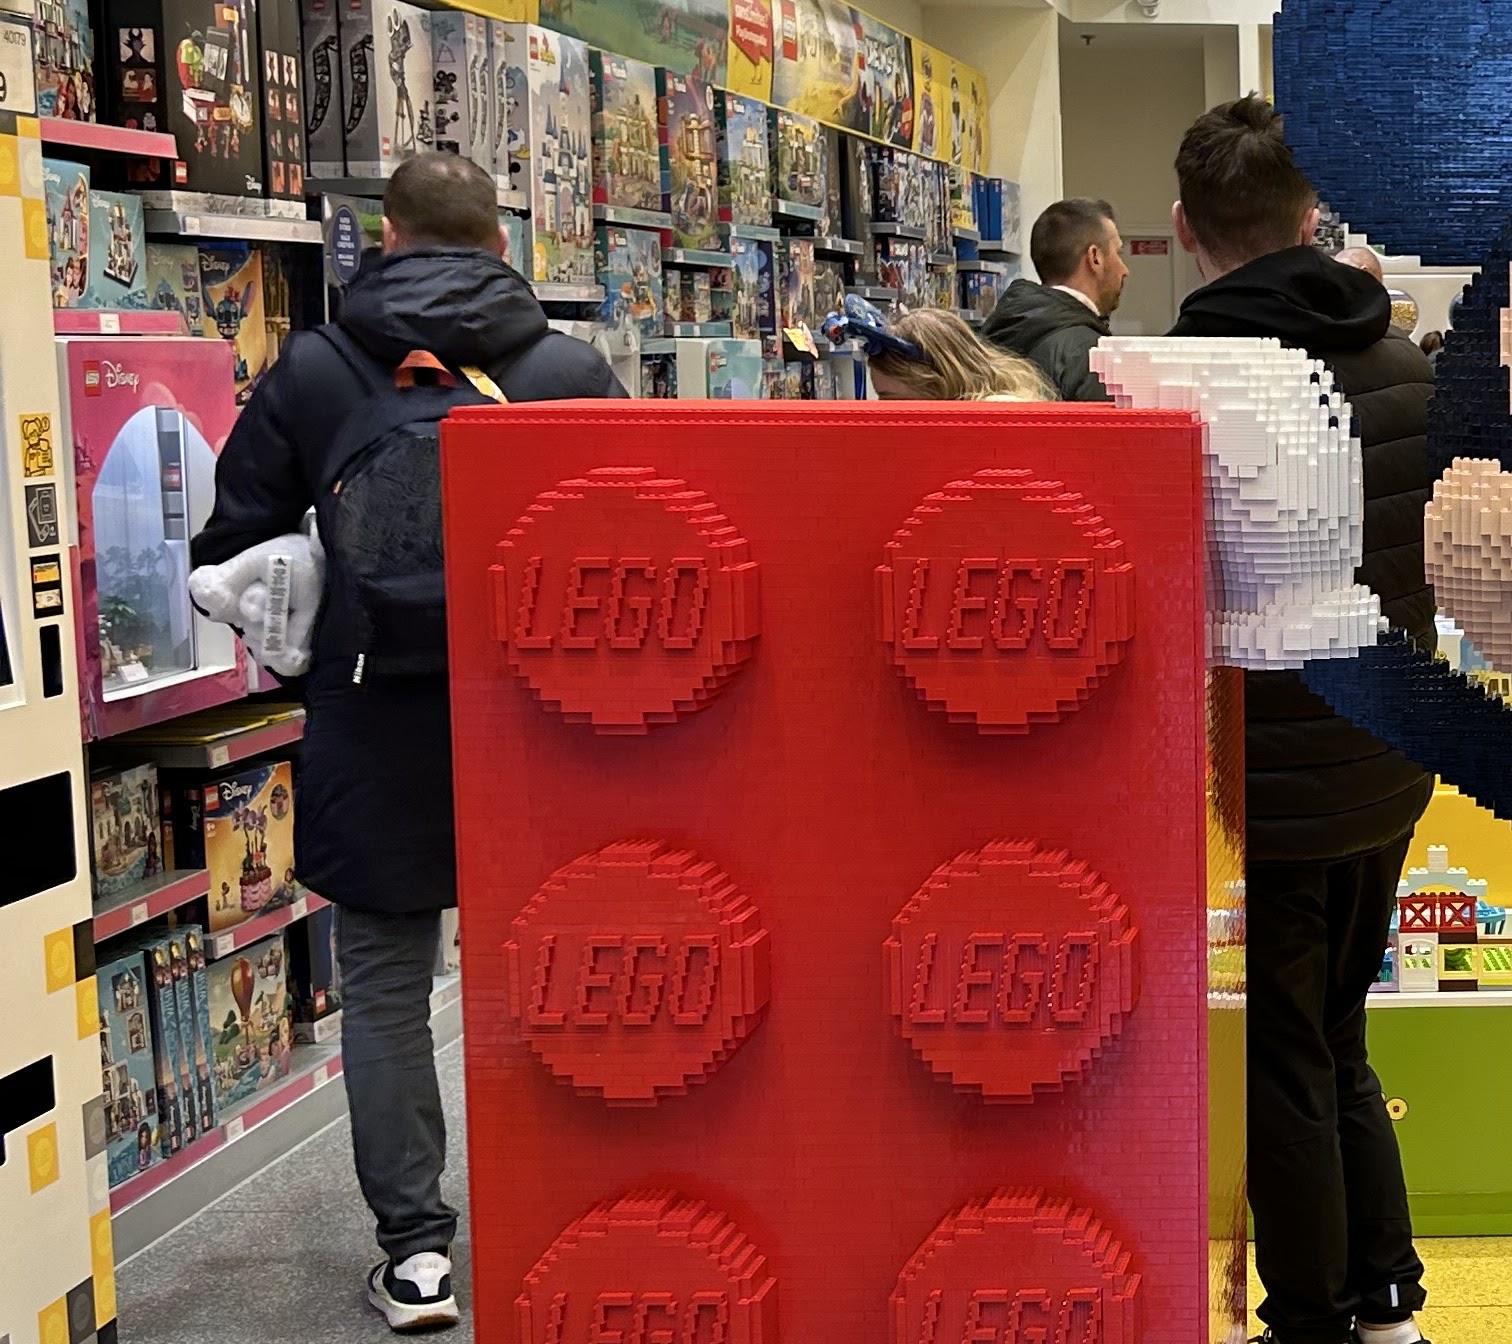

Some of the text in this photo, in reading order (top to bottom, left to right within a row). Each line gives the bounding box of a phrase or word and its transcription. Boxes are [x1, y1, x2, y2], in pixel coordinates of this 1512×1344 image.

[102, 360, 140, 394] Disney
[513, 556, 710, 650] LEGO
[901, 557, 1096, 650] LEGO
[526, 934, 720, 1027] LEGO
[909, 930, 1099, 1025] LEGO
